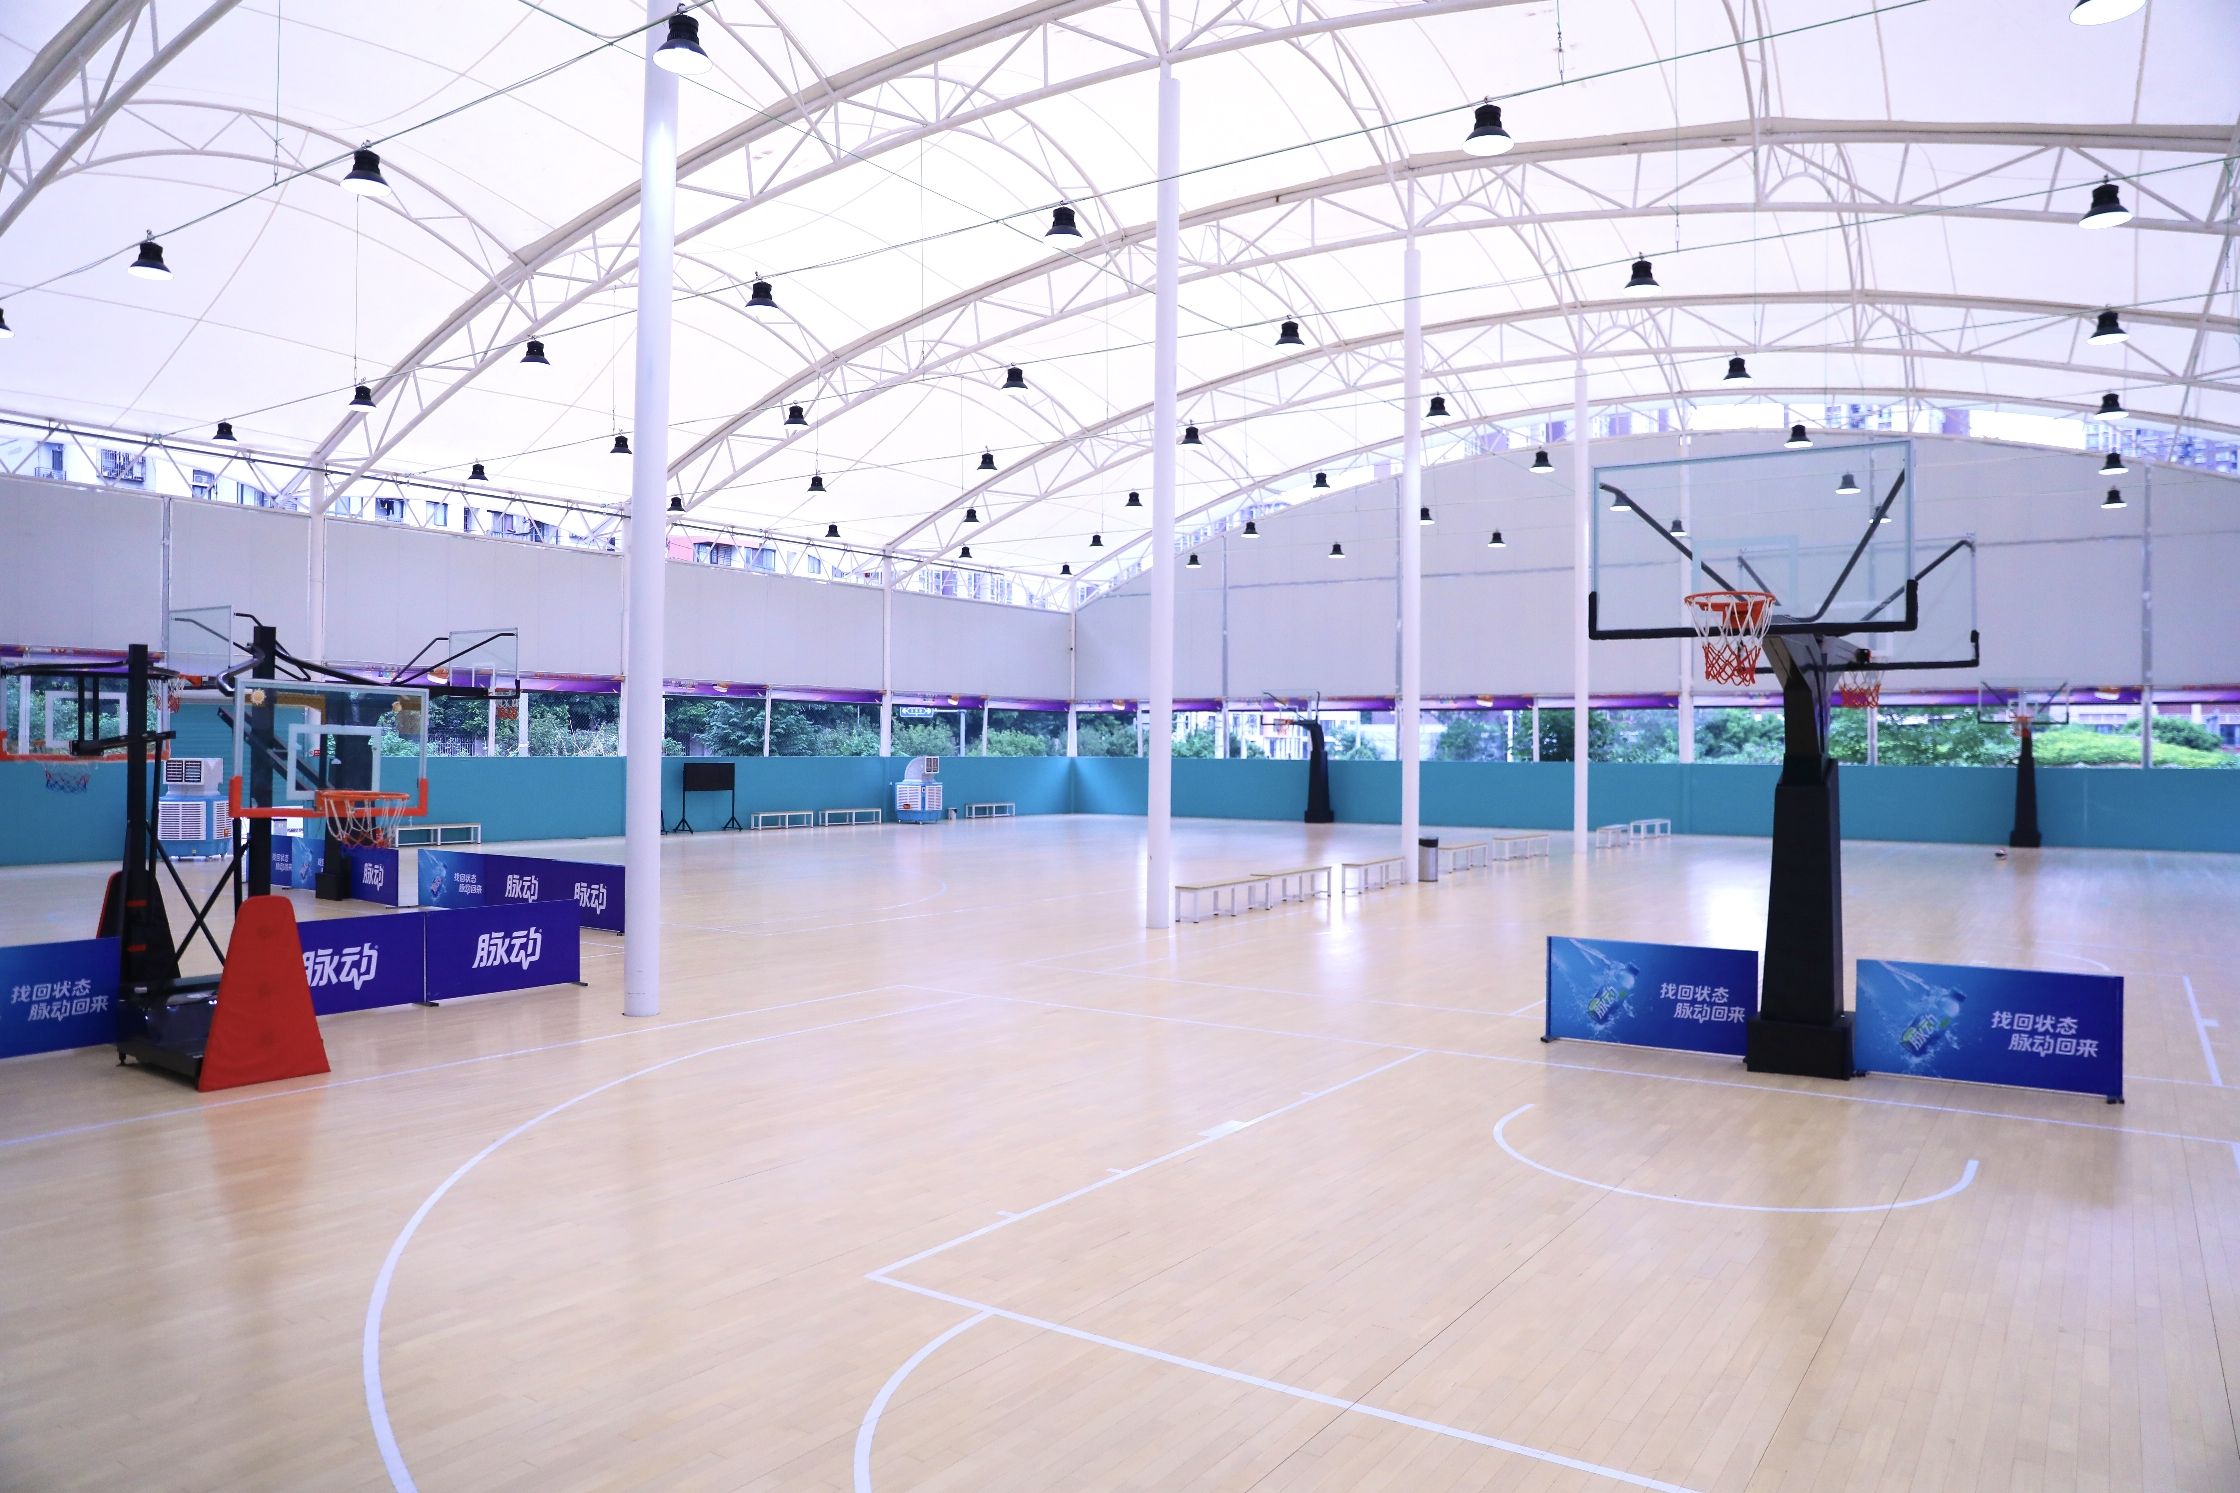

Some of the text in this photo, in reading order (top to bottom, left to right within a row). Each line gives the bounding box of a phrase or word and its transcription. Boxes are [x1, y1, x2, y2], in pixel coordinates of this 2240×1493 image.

[362, 863, 384, 891] 脉动
[505, 874, 538, 903] 脉动
[573, 881, 606, 915] 脉动
[472, 926, 541, 970] 脉动
[302, 942, 378, 990] 脉动
[10, 978, 92, 1004] 找回状态
[1659, 982, 1729, 1003] 找回状态
[27, 995, 109, 1021] 脉动回来
[1673, 1002, 1745, 1024] 脉动回来
[1991, 1010, 2078, 1035] 找回状态
[2008, 1033, 2099, 1058] 脉动回来
